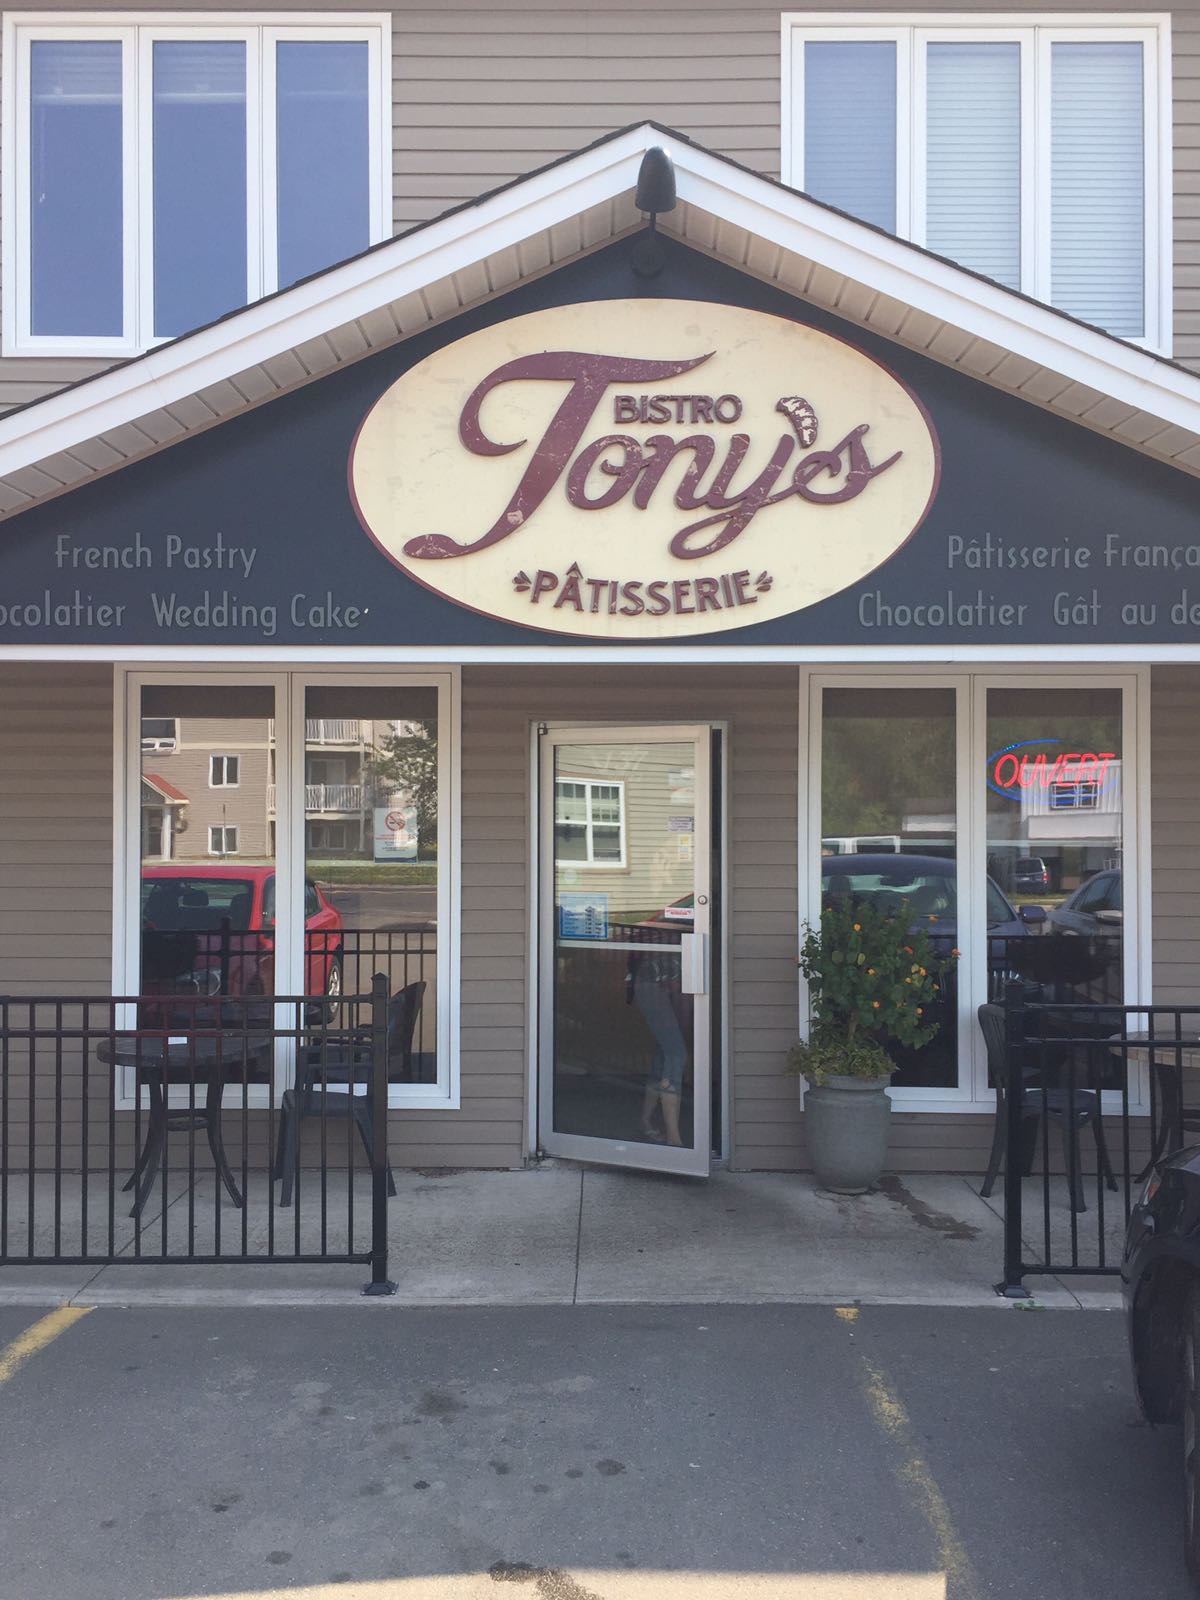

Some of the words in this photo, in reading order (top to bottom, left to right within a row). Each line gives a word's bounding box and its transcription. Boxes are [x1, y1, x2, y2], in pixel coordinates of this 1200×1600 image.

[613, 393, 743, 425] BISTRO
[55, 532, 152, 569] French
[166, 532, 257, 578] Pastry
[948, 532, 1091, 569] Pâtisserie
[529, 561, 759, 617] PÂTISSERIE
[858, 590, 1028, 627] Chocolatier
[1053, 589, 1102, 627] Gât
[1121, 603, 1155, 626] au
[151, 590, 278, 636] Wedding
[290, 591, 361, 629] Cake
[994, 753, 1116, 789] OUVERT
